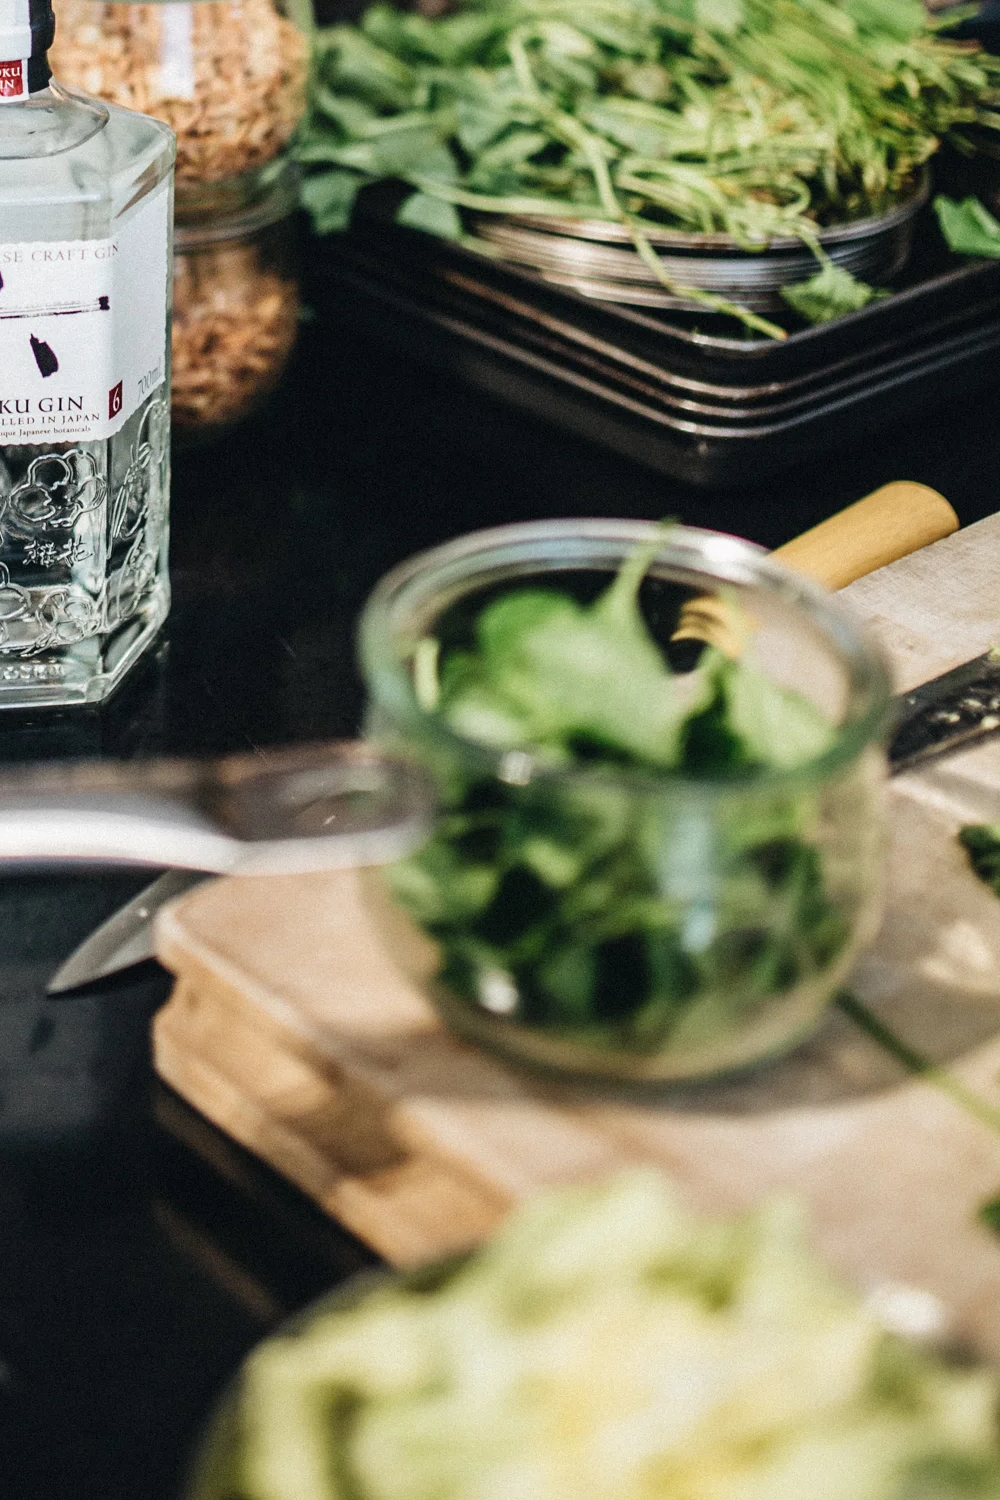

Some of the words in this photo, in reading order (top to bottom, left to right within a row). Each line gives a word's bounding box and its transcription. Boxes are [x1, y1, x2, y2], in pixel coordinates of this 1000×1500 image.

[31, 248, 87, 262] CRAFT
[94, 241, 119, 259] GIN
[38, 396, 84, 412] GIN
[112, 387, 120, 412] 6
[41, 415, 56, 425] IN
[62, 413, 100, 425] JAPAN
[19, 428, 51, 438] Japanese
[53, 424, 91, 435] botanicals
